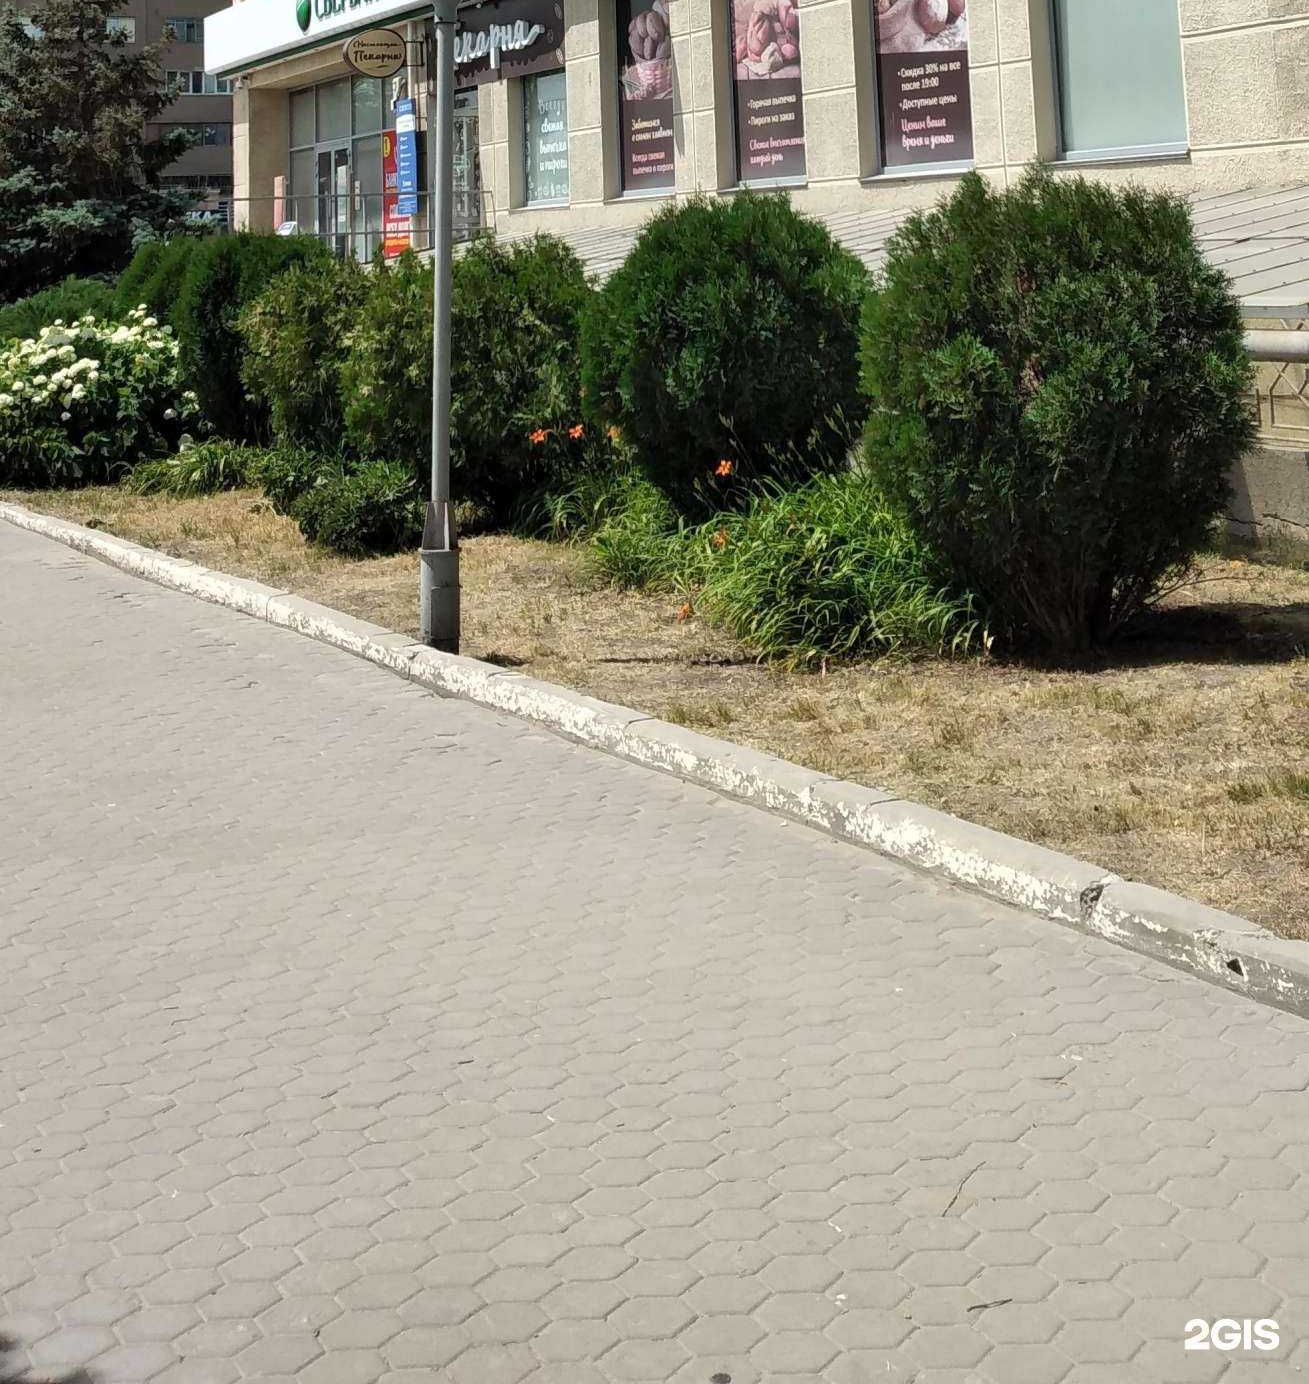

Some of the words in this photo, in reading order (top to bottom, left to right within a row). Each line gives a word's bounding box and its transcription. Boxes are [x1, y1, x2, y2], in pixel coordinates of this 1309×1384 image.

[453, 19, 545, 70] екарня
[353, 49, 403, 63] Пекарня
[901, 67, 924, 78] Скидка
[925, 63, 939, 74] 30%
[939, 63, 948, 72] на
[949, 61, 961, 70] все
[901, 81, 920, 91] после
[921, 76, 940, 89] 19:00
[902, 97, 938, 111] Доступные
[938, 94, 957, 106] цены
